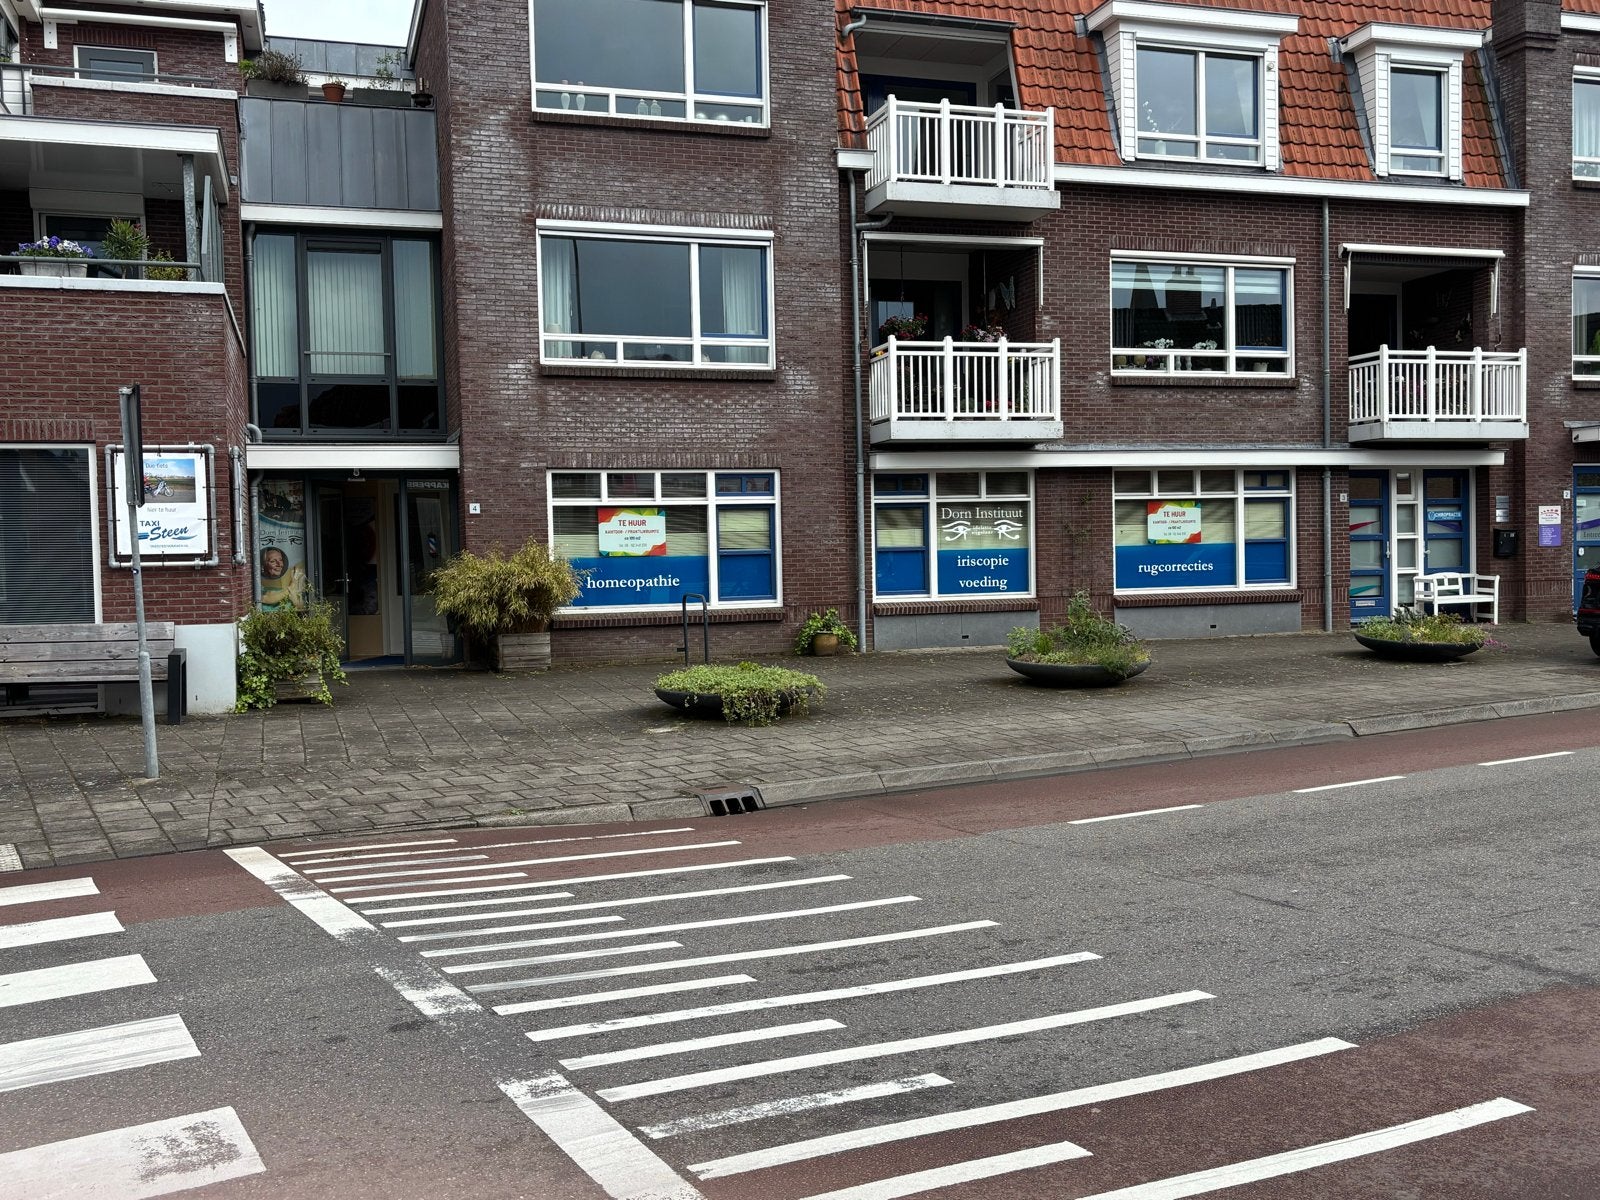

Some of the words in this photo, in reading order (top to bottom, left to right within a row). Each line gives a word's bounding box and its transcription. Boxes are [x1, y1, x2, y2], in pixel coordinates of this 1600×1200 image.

[941, 507, 972, 519] Dorn
[975, 506, 1024, 519] Instituut
[618, 519, 627, 527] TE
[149, 526, 189, 541] Steen
[957, 555, 1009, 569] iriscopie
[1138, 560, 1214, 575] rugcorrecties
[586, 574, 680, 592] homeopathie
[959, 576, 1008, 590] voeding
